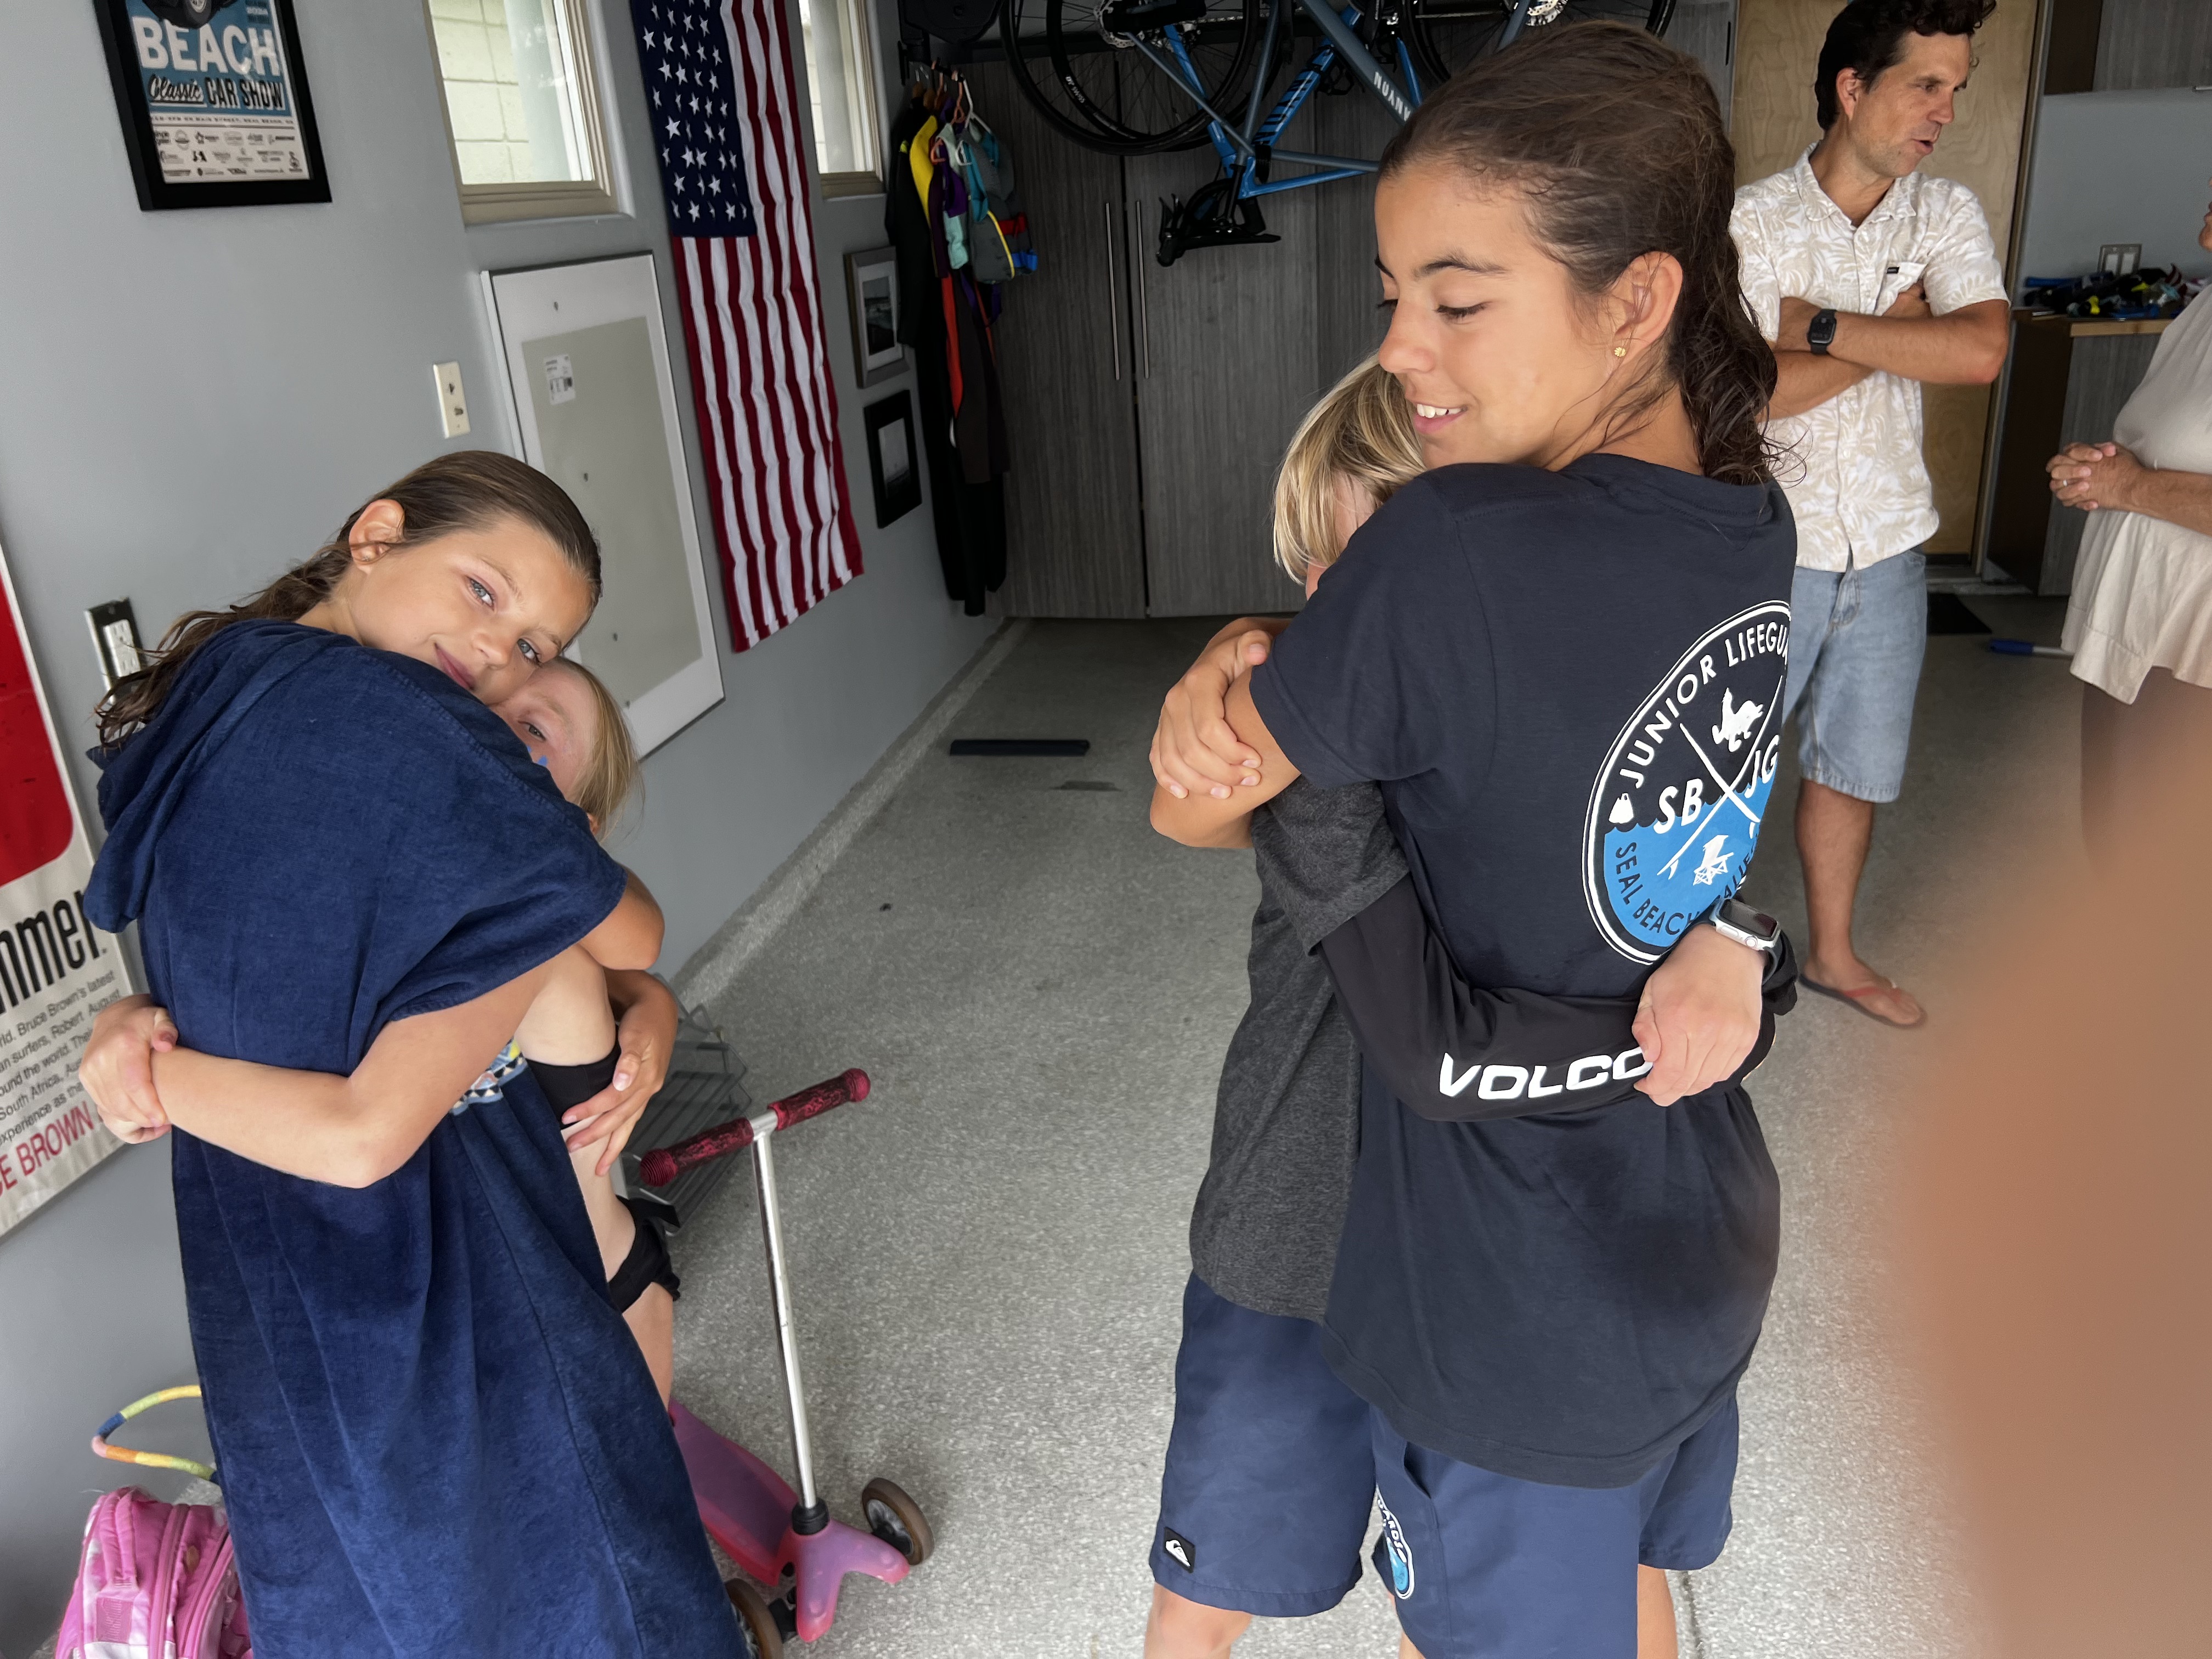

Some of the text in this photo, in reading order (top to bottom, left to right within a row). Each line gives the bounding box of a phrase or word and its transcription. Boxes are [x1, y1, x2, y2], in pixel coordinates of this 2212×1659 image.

[132, 16, 281, 76] BEACH
[149, 74, 285, 110] Classic CAR SHOW
[1374, 71, 1410, 121] ANYON
[1620, 654, 1718, 789] JUNIOR
[1744, 734, 1779, 798] JG
[1654, 778, 1703, 834] SB
[1615, 841, 1642, 905] SEAL
[16, 1012, 47, 1036] Bruce
[46, 988, 87, 1016] Brown's
[87, 970, 115, 992] latest
[50, 1011, 84, 1039] Robert
[23, 1063, 41, 1080] the
[1439, 1047, 1653, 1099] VOLCO
[0, 1093, 29, 1120] South
[52, 1093, 67, 1108] as
[16, 1100, 94, 1176] BROWN
